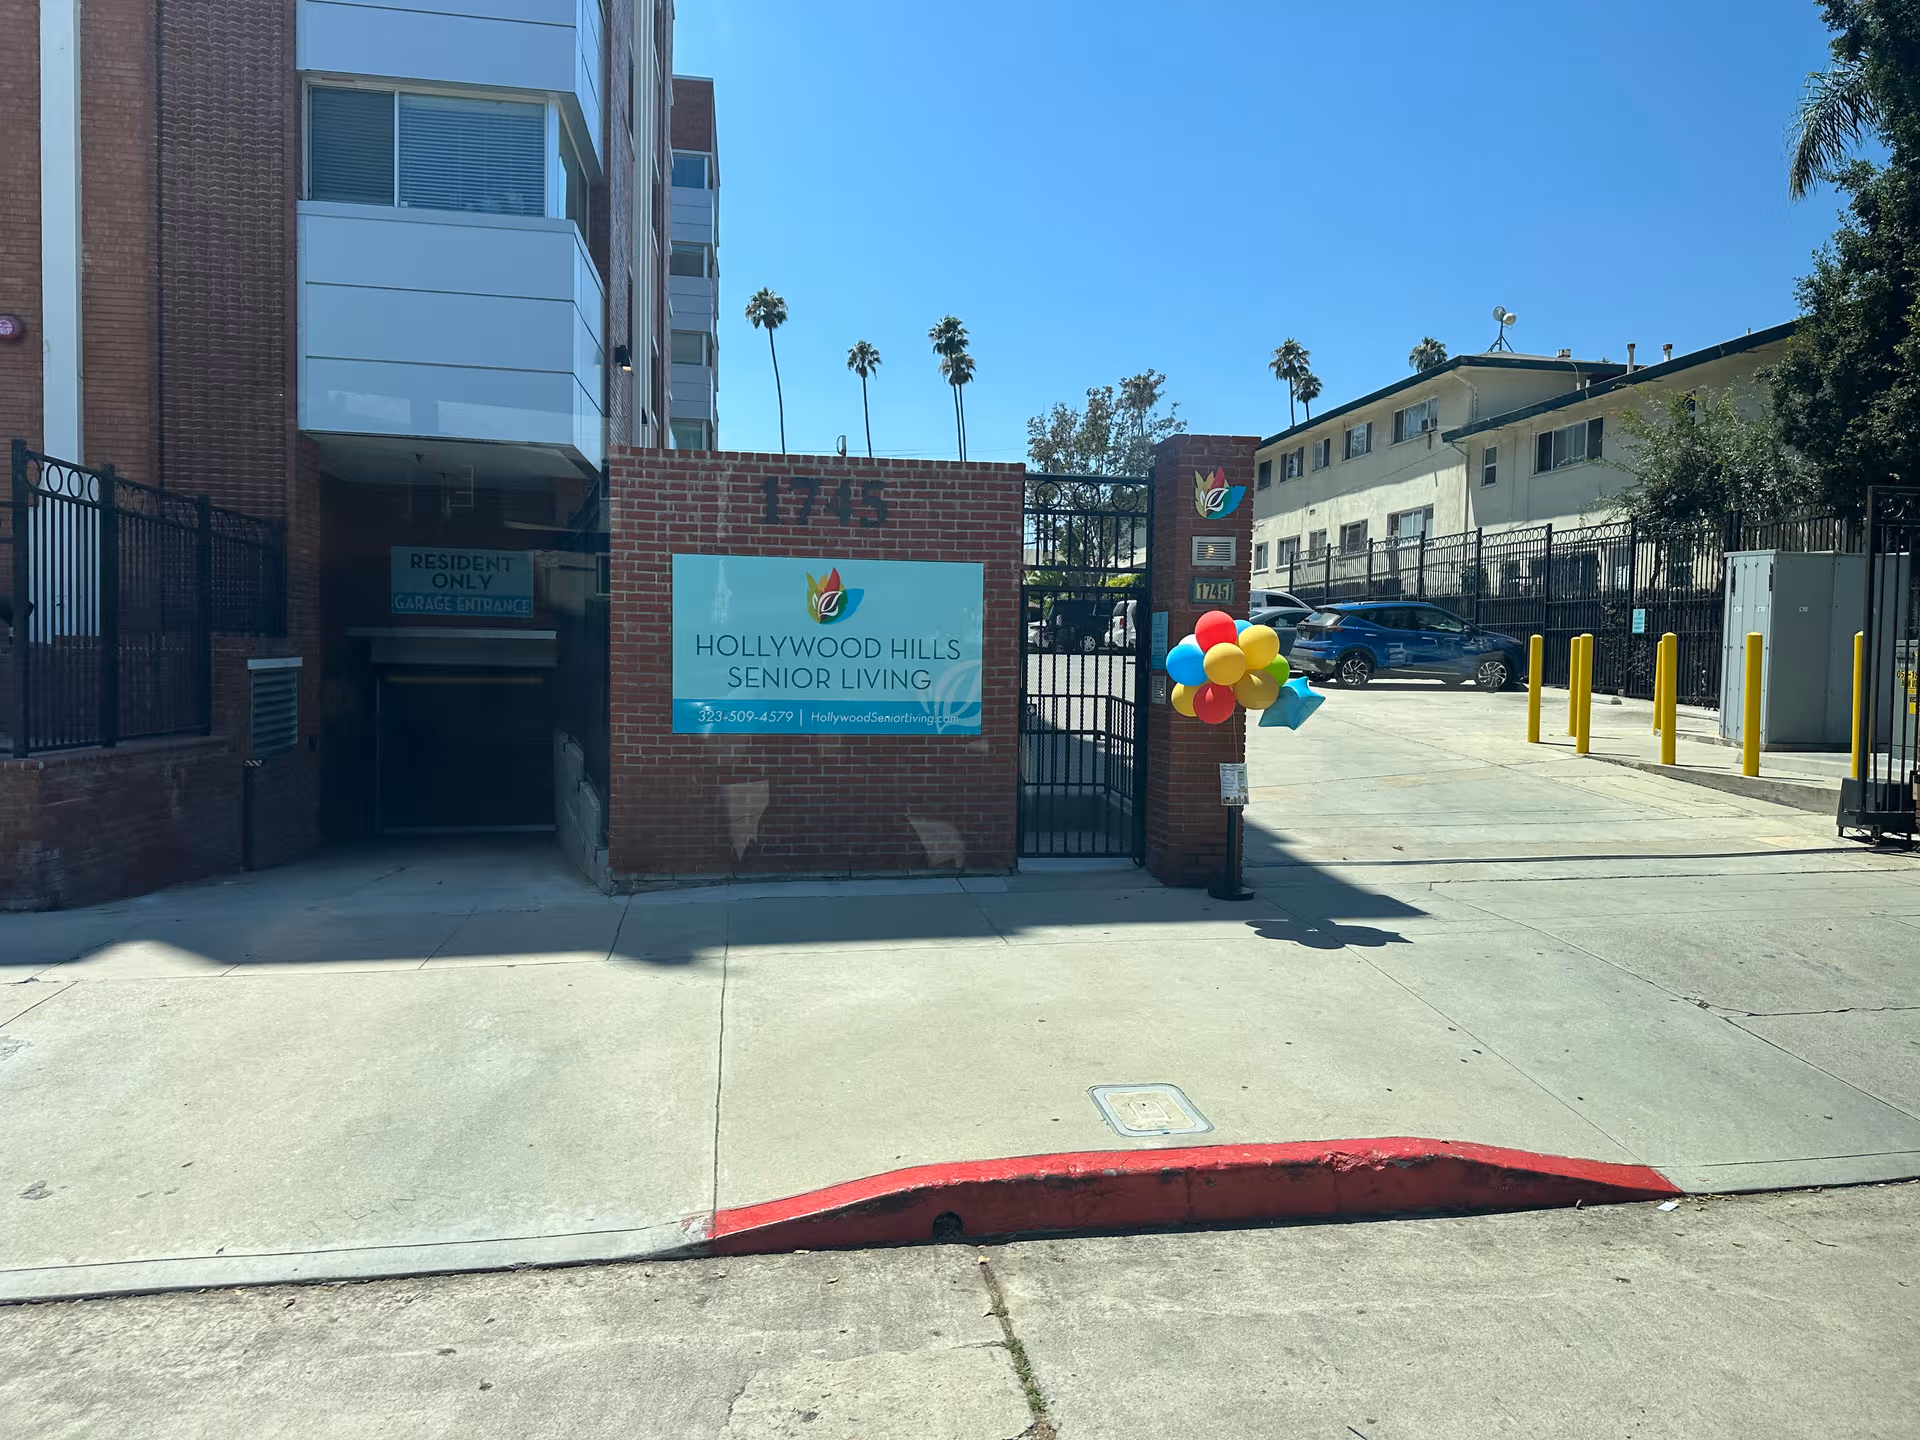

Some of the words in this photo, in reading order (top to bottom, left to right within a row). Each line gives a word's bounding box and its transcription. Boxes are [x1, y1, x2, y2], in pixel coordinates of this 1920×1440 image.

[760, 477, 888, 528] 1745
[410, 553, 514, 573] RESIDENT
[431, 573, 493, 591] ONLY
[1198, 583, 1228, 599] 1745
[394, 595, 452, 611] GARAGE
[457, 597, 530, 614] ENTRANCE
[696, 634, 881, 659] HOLLYWOOD
[891, 638, 961, 660] HILLS
[727, 666, 831, 689] SENIOR
[841, 668, 932, 690] LIVING
[697, 710, 794, 723] 323-509-4579
[810, 711, 960, 725] HollywoodSeniorLiving.com
